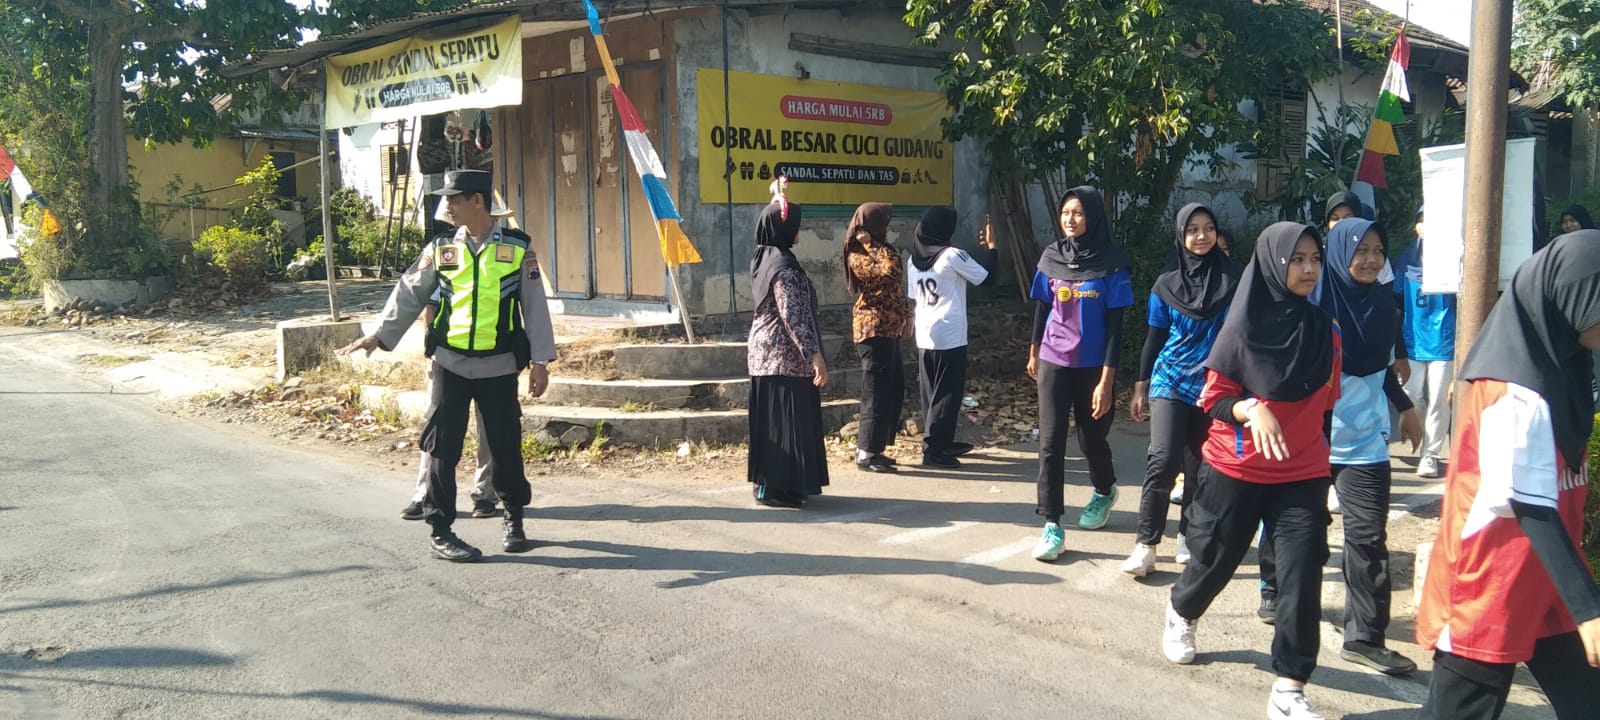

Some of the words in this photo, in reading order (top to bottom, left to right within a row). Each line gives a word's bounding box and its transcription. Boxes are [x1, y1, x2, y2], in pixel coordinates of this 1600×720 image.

[342, 58, 384, 86] OBRAL
[387, 46, 439, 75] SANDAL
[440, 33, 499, 68] SEPATU
[383, 87, 411, 102] HARGA
[788, 101, 827, 116] HARGA
[829, 103, 863, 119] MULAI
[866, 105, 886, 121] 5RB
[711, 126, 776, 150] OBRAL
[780, 130, 837, 154] BESAR
[841, 133, 880, 156] CUCI
[883, 137, 945, 160] GUDANG
[780, 166, 821, 179] SANDAL,
[822, 168, 855, 180] SEPATU
[857, 169, 876, 180] DAN
[878, 169, 895, 182] TAS
[916, 277, 940, 307] 18
[1072, 288, 1100, 299] Spotify
